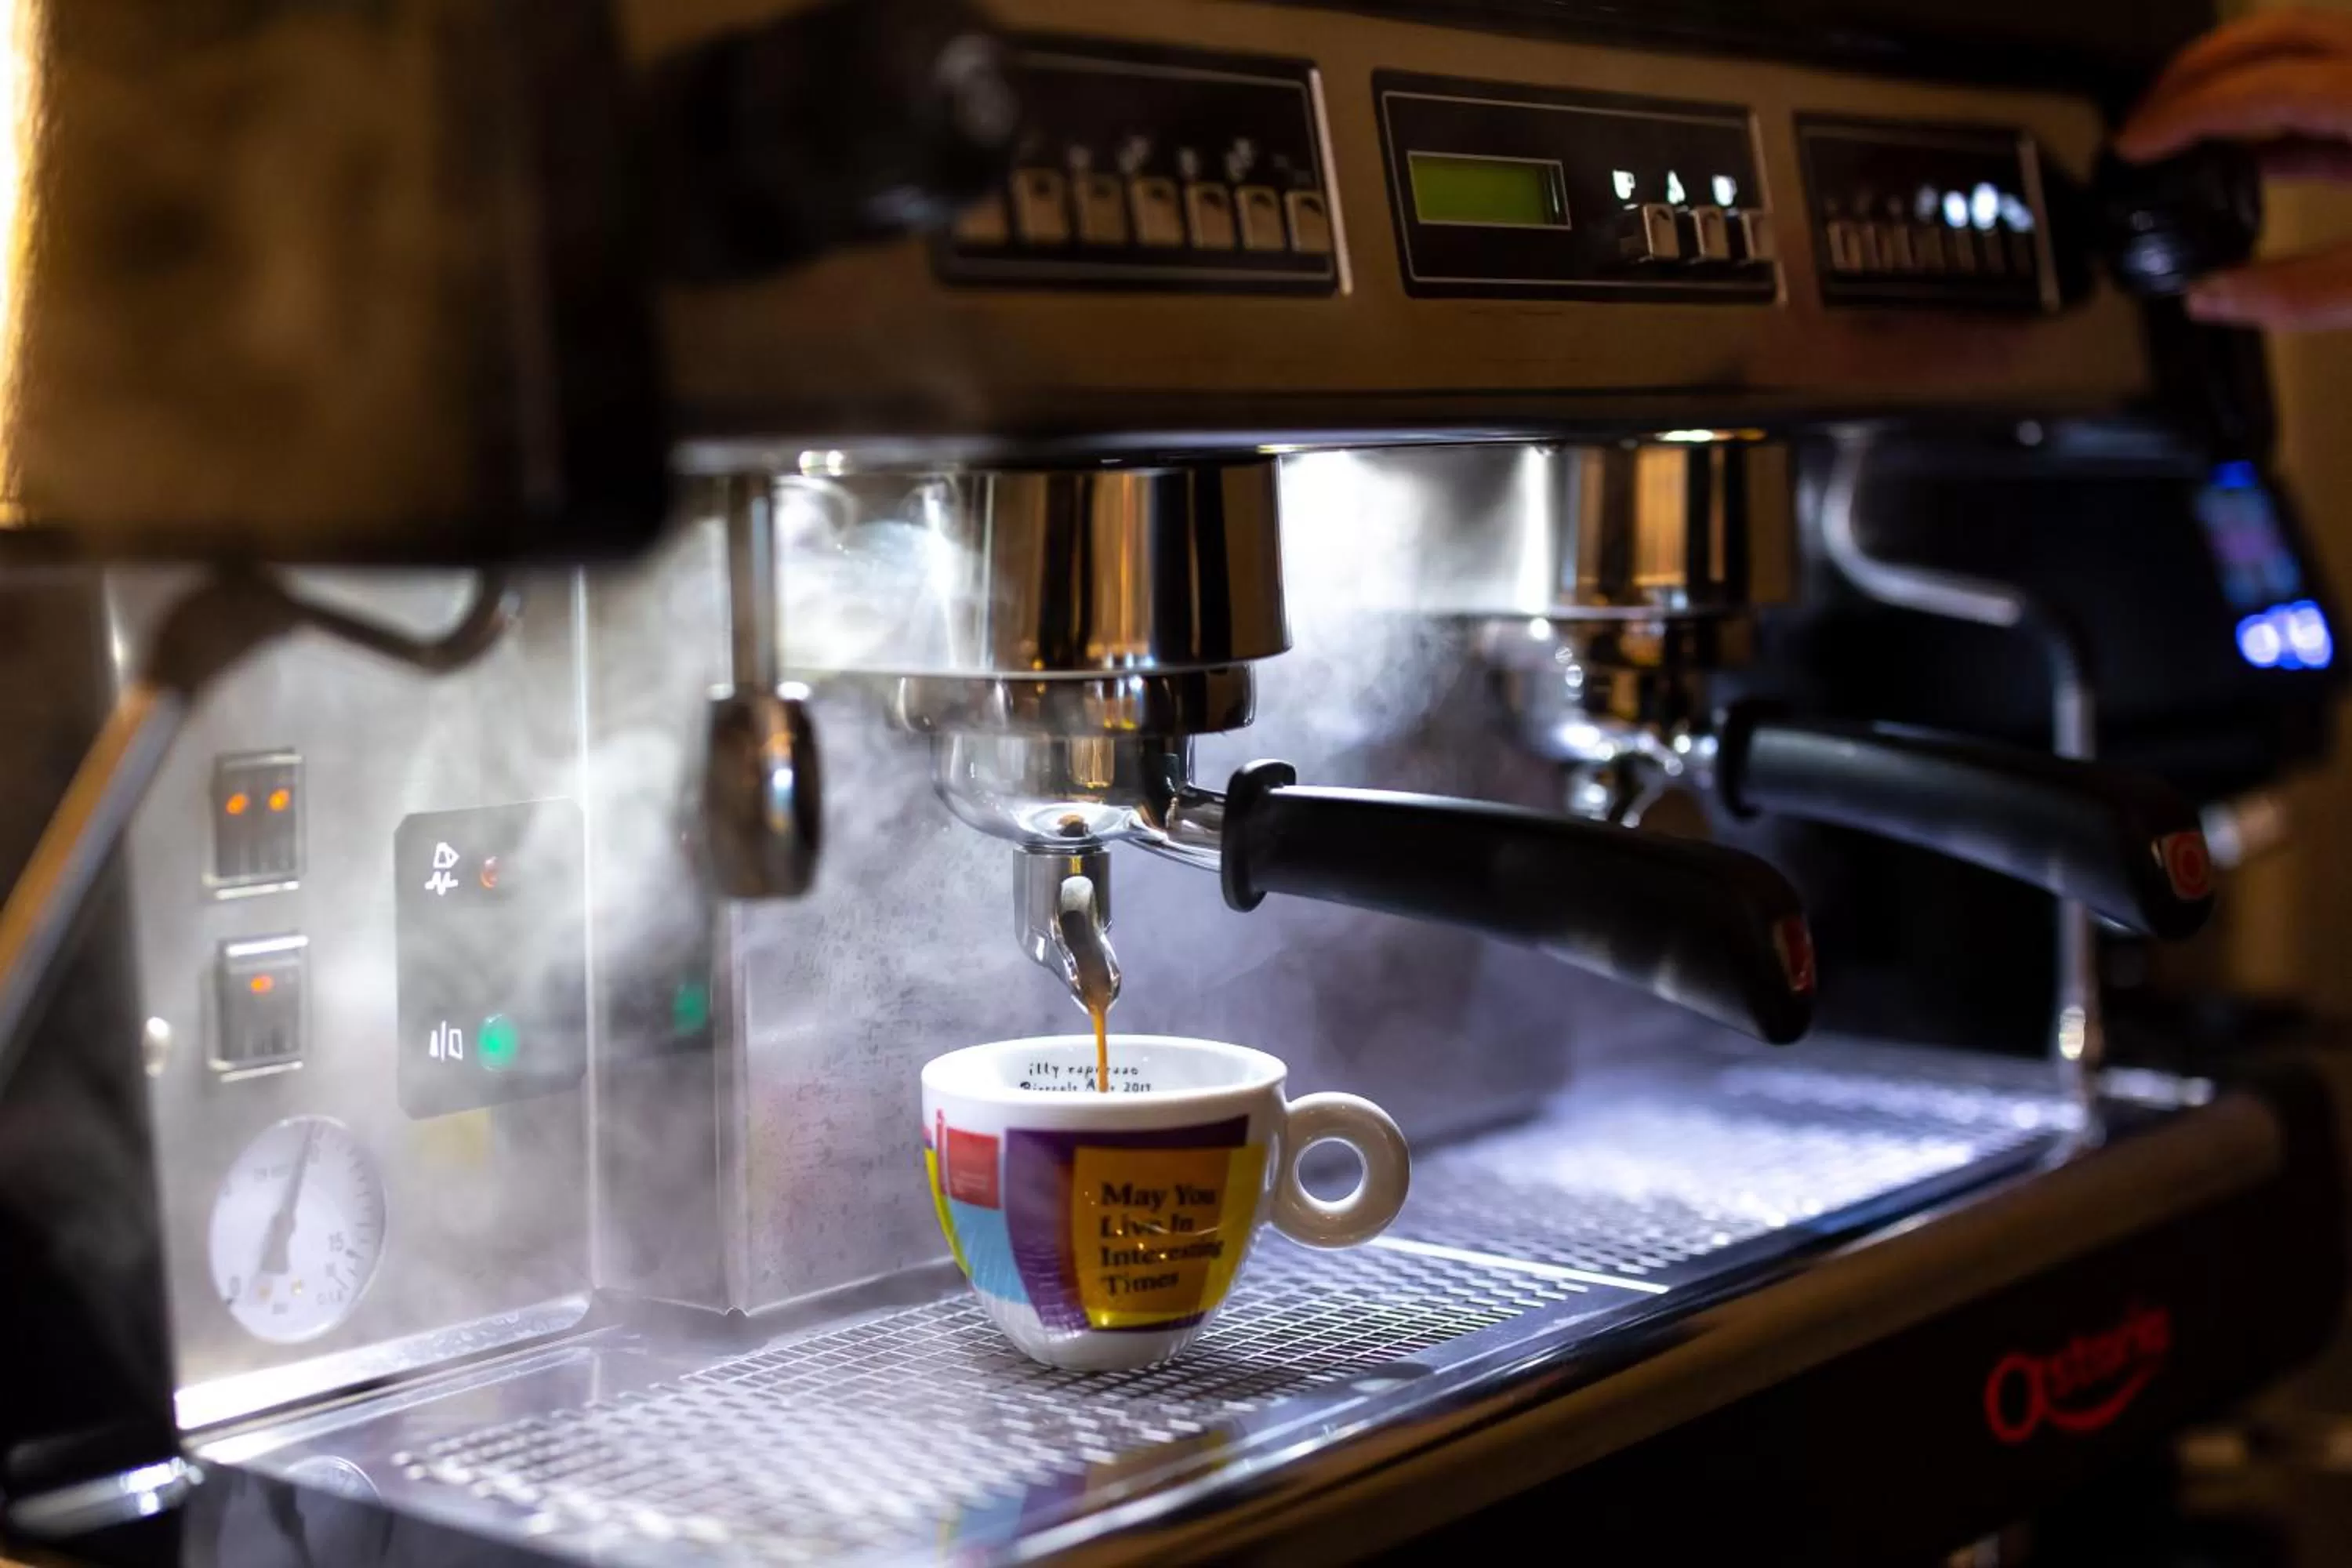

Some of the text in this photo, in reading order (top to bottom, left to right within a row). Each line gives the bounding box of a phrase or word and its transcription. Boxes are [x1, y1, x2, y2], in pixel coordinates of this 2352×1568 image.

[1029, 1062, 1139, 1080] illy espsso
[1085, 1078, 1116, 1092] Ae
[1101, 1182, 1217, 1213] May You
[1101, 1213, 1194, 1238] Live In
[1100, 1271, 1180, 1296] Times
